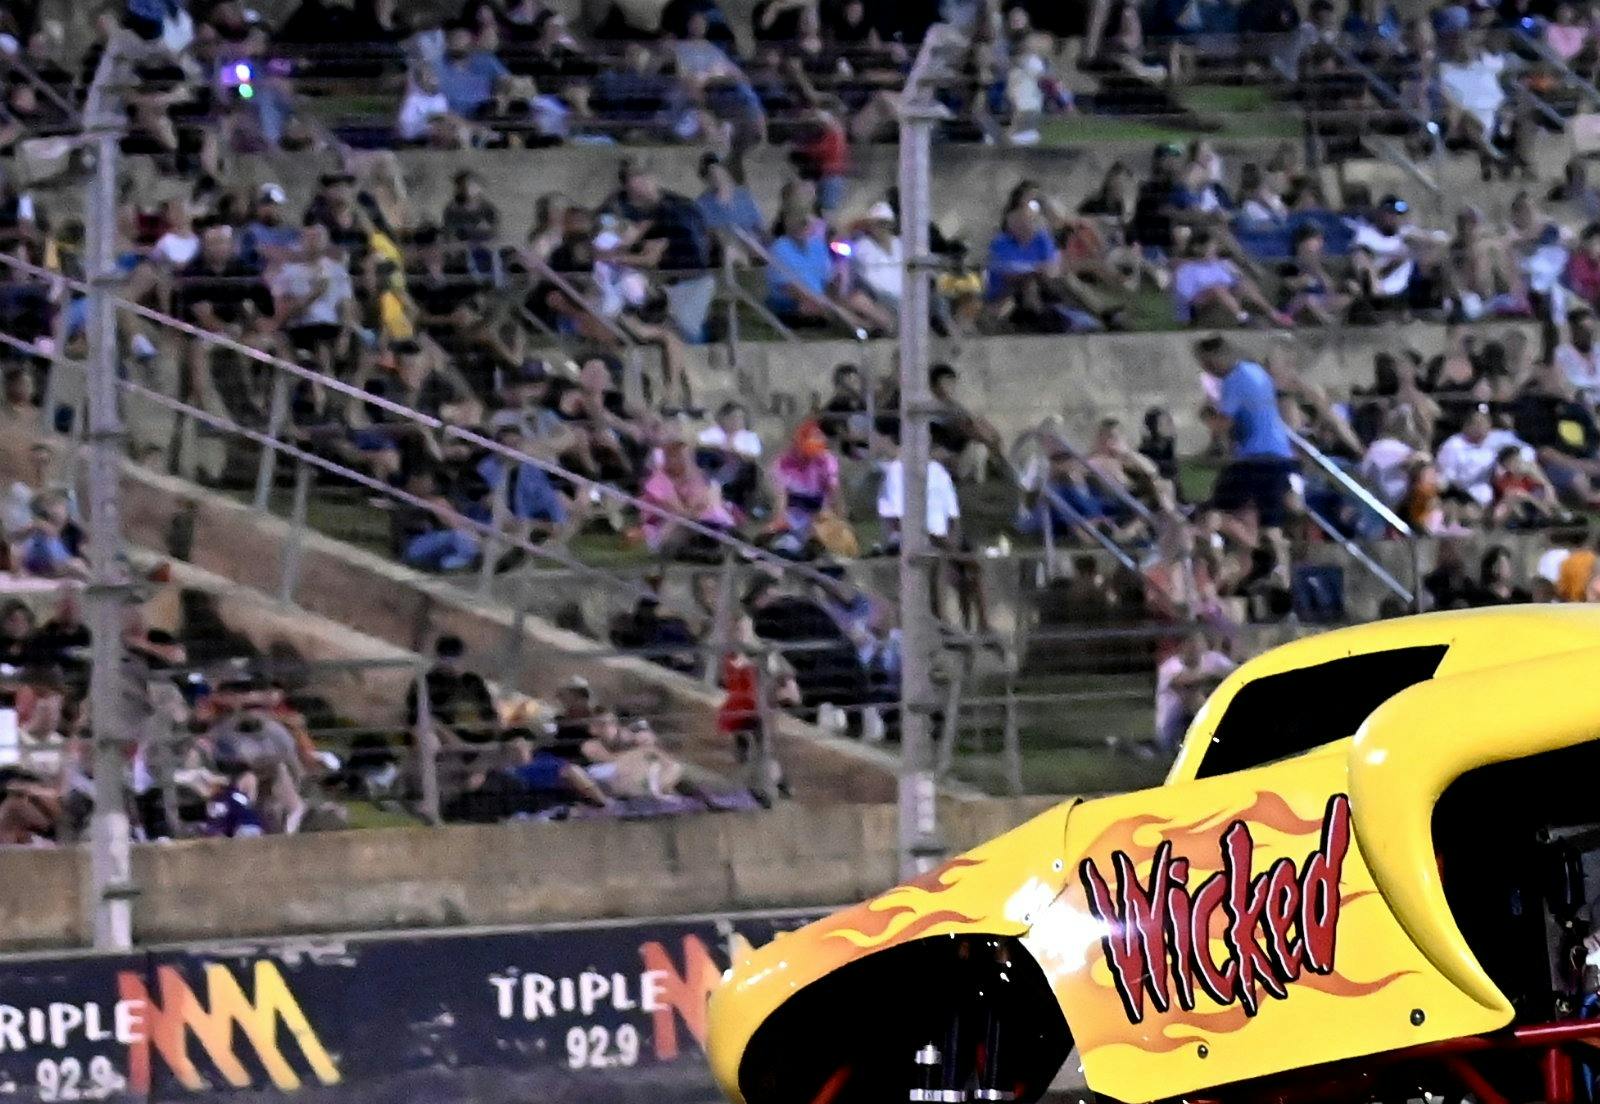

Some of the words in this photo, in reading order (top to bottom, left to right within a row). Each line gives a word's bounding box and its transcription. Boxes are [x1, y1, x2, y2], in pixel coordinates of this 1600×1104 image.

[1079, 793, 1351, 1024] Wicked
[489, 969, 669, 1020] TRIPLE
[566, 1022, 640, 1069] 92.9
